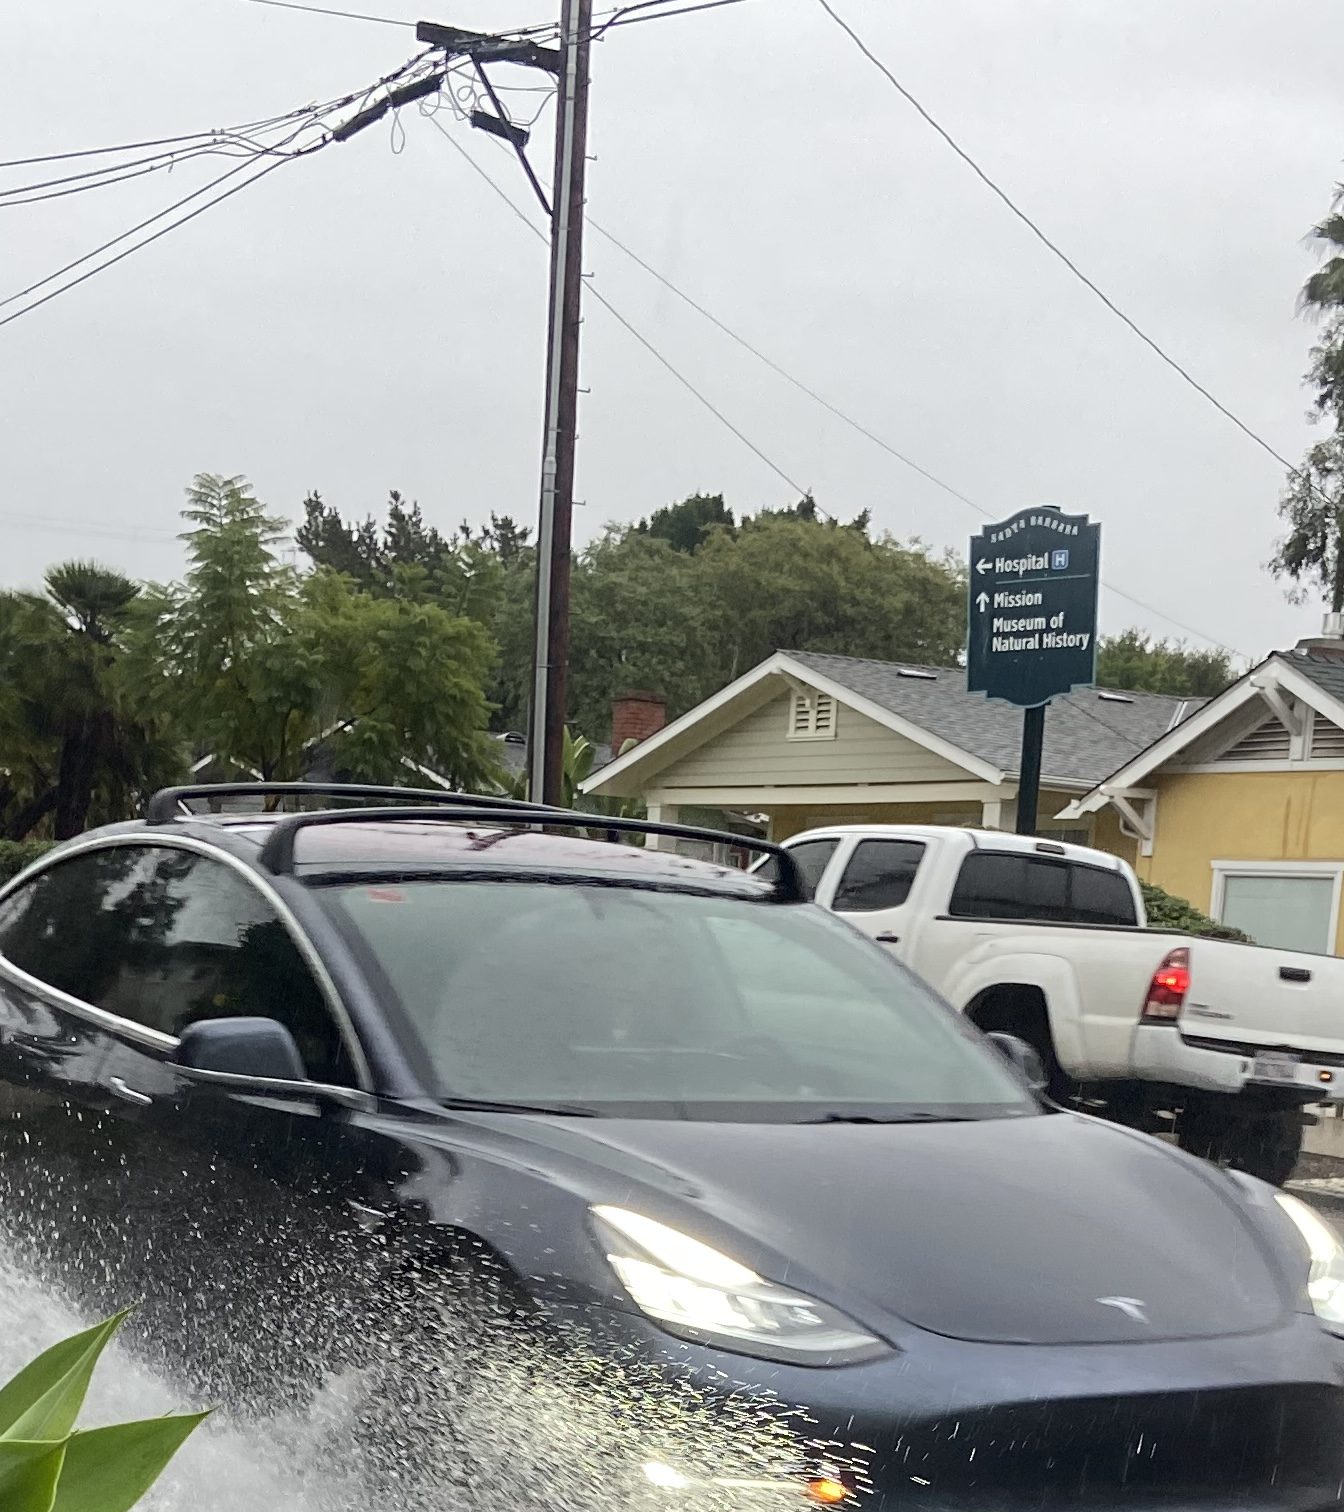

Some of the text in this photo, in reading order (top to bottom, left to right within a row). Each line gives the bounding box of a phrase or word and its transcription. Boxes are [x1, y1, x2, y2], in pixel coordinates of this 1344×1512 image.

[995, 551, 1049, 578] Hospital
[993, 590, 1043, 609] Mission
[992, 611, 1064, 633] Museum of
[992, 631, 1090, 652] Natural History
